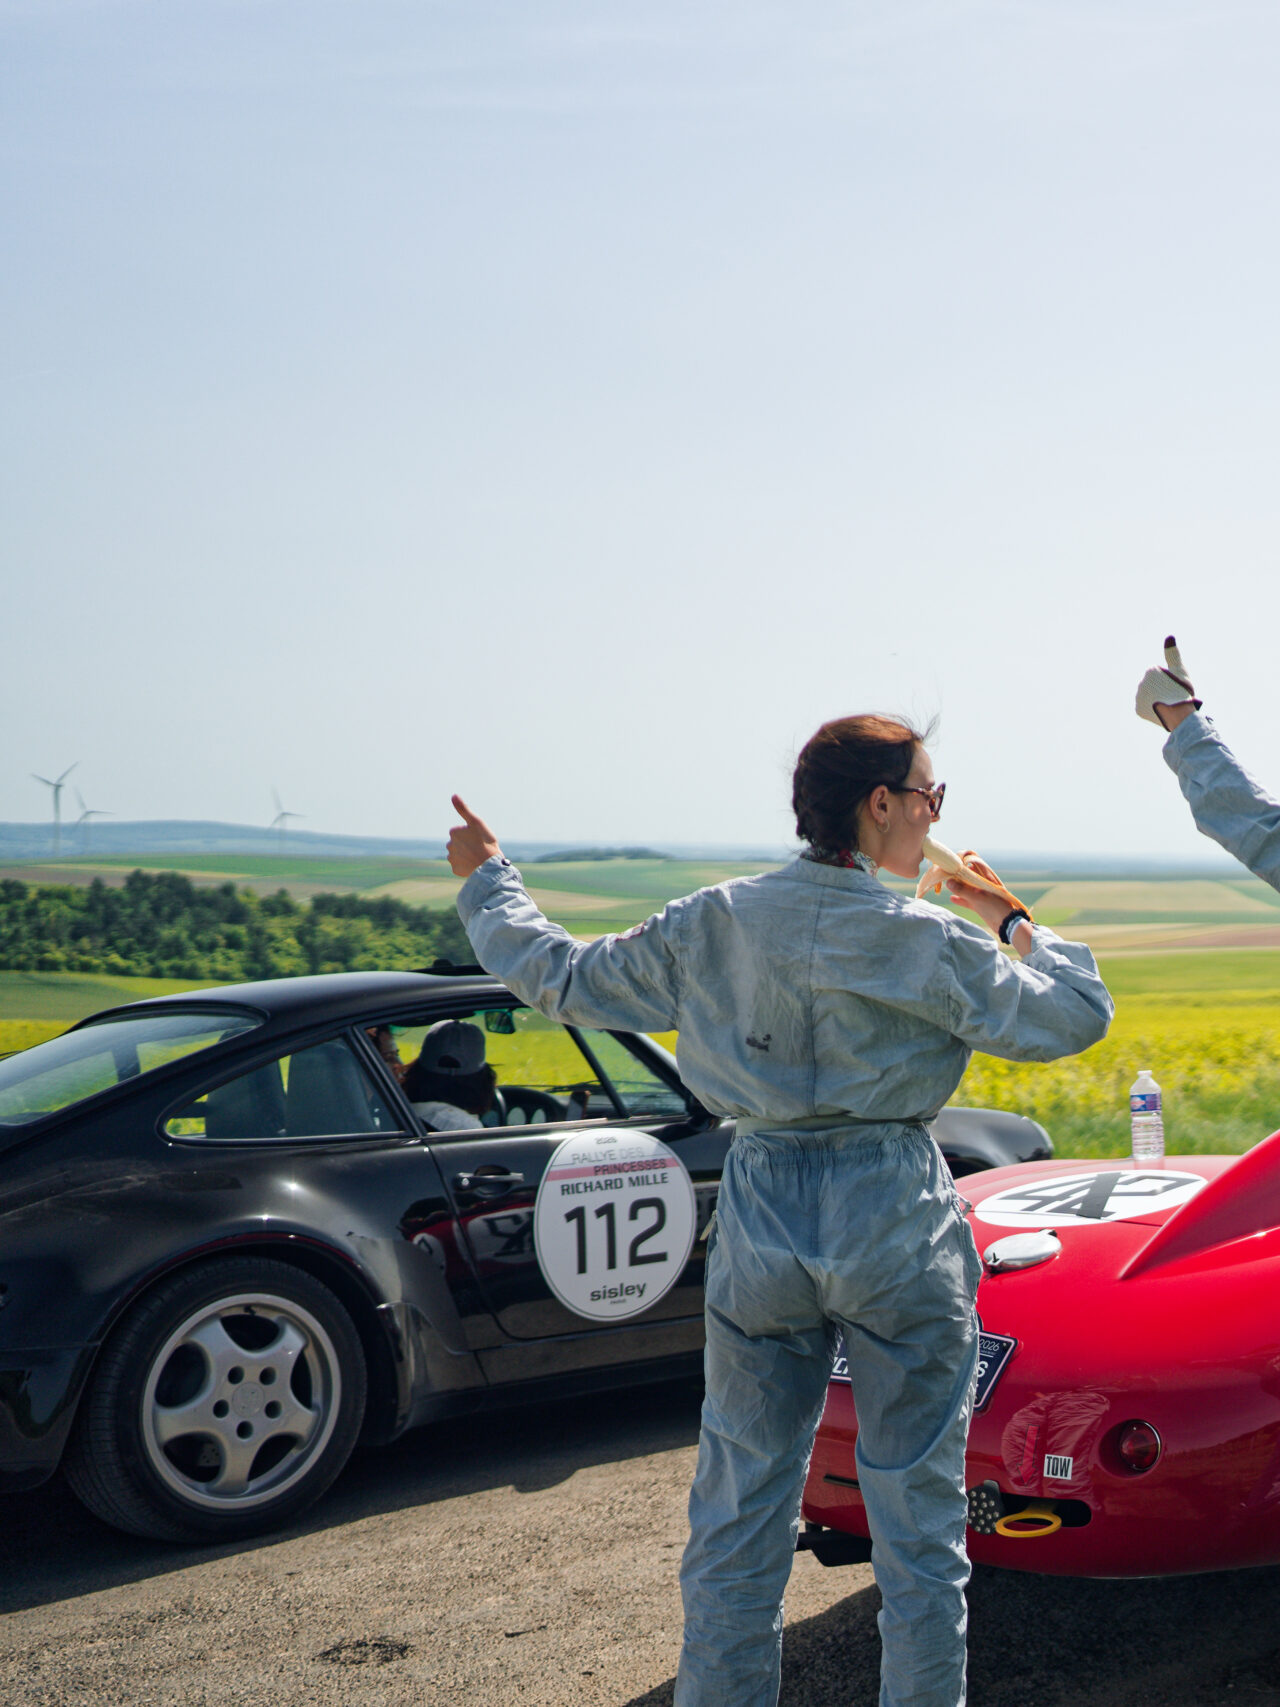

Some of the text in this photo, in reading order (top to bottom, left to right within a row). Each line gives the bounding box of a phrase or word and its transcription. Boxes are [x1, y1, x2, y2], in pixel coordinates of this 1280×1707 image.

[572, 1147, 644, 1164] RALLYE DES
[594, 1159, 667, 1175] PRINCESSES
[561, 1172, 669, 1195] RICHARD MILLE
[564, 1197, 668, 1275] 112
[590, 1282, 646, 1301] sisley
[979, 1338, 1000, 1352] 2026
[1046, 1455, 1071, 1478] TOW
